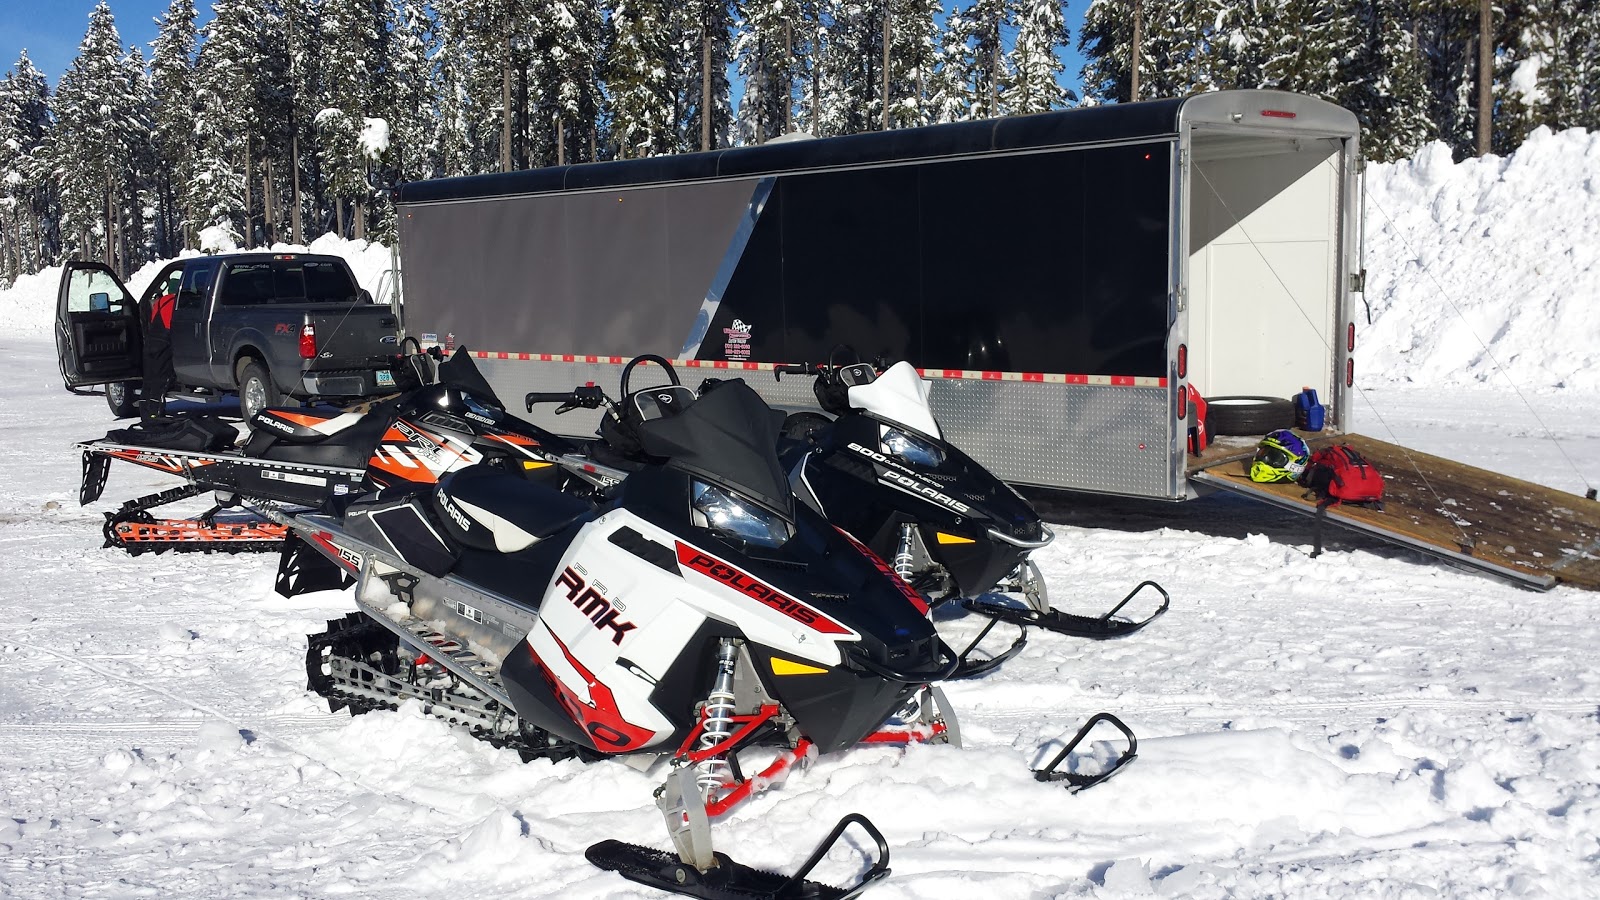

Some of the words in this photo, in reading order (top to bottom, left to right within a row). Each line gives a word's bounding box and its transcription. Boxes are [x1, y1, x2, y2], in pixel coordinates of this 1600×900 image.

[275, 324, 296, 334] FX4
[257, 414, 295, 435] POLARIS
[847, 442, 887, 462] 800
[883, 470, 971, 514] POLARIS
[437, 487, 471, 532] POLARIS
[338, 548, 361, 567] 155
[688, 553, 821, 625] POLARIS
[554, 565, 638, 647] RMK
